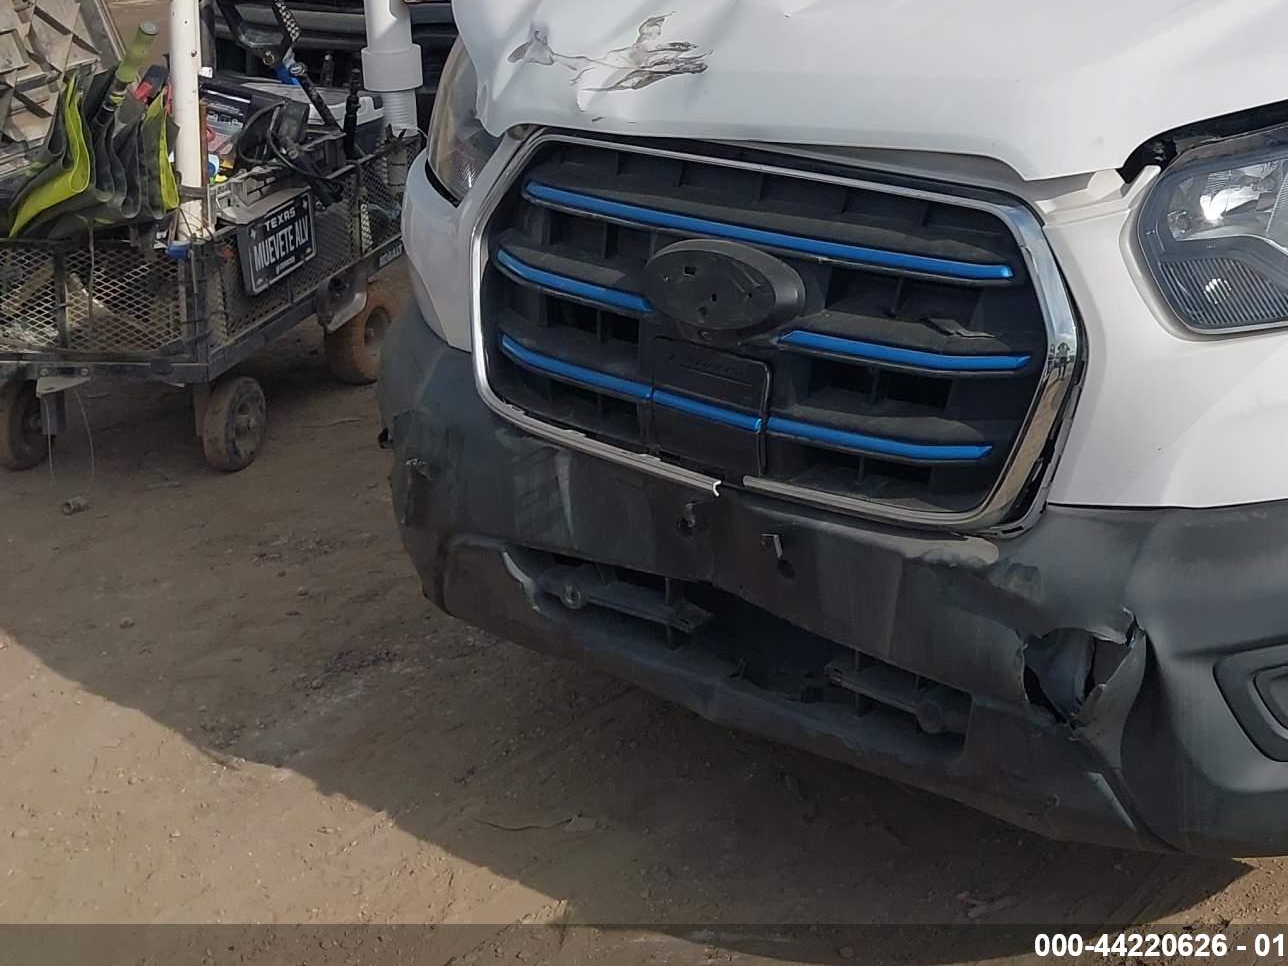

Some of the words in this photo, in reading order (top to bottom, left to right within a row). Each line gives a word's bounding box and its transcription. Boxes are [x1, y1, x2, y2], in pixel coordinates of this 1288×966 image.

[264, 207, 296, 232] TEXAS
[254, 225, 295, 272] MUEVETE
[295, 216, 309, 248] ALV
